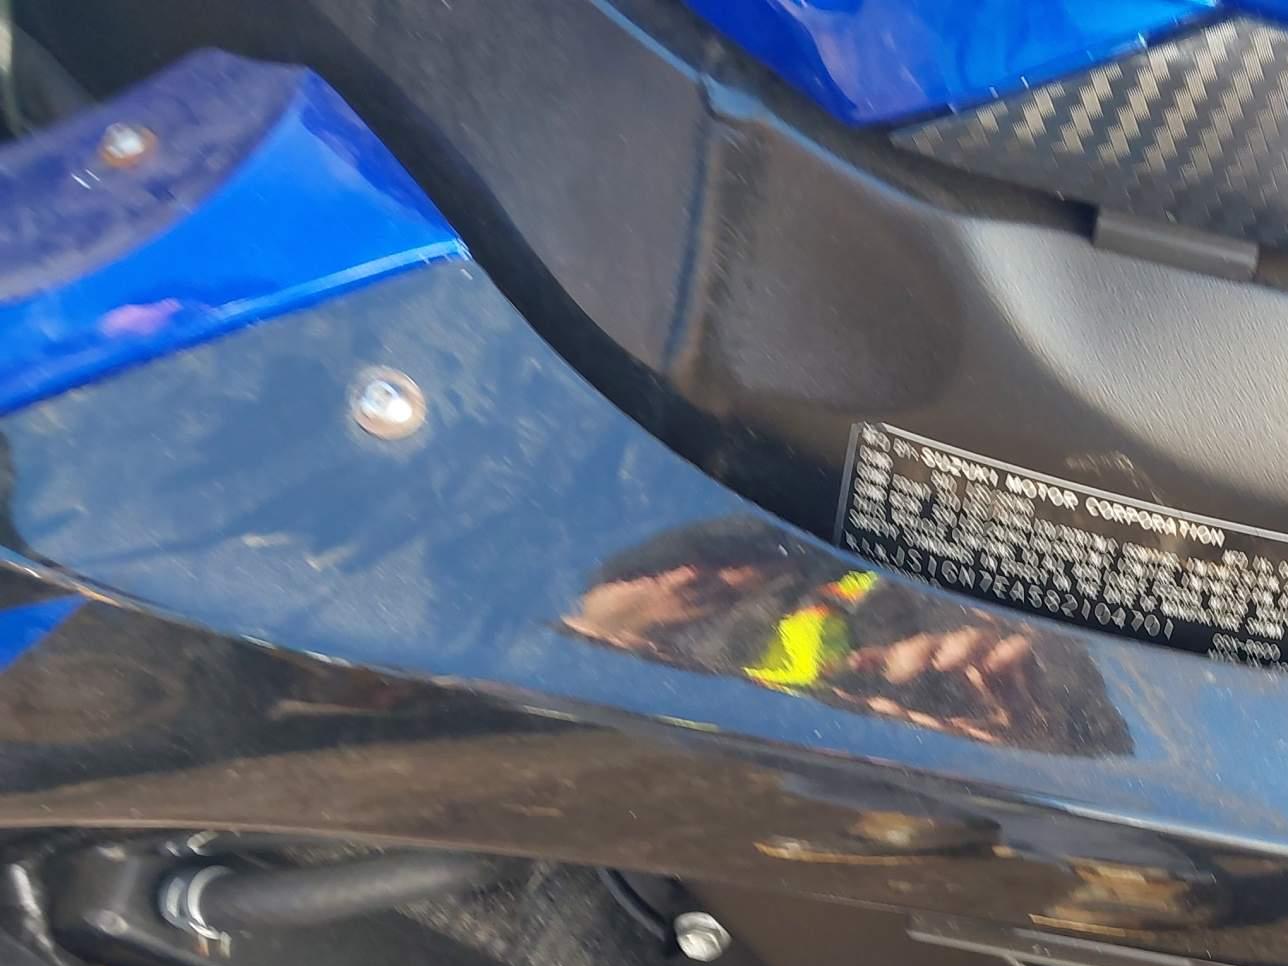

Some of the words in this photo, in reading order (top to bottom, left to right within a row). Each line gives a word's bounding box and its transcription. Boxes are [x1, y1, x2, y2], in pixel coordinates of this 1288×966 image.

[890, 508, 949, 543] VEHICLE
[920, 447, 998, 486] SUZUKI
[1006, 474, 1078, 510] MOTOR
[1085, 497, 1225, 547] CORPORATION
[849, 509, 900, 541] SAFETY
[980, 553, 998, 572] IN
[1052, 572, 1072, 592] ON
[1076, 578, 1102, 600] THE
[1245, 617, 1285, 640] SHOWN
[1212, 632, 1281, 661] GSX-R600
